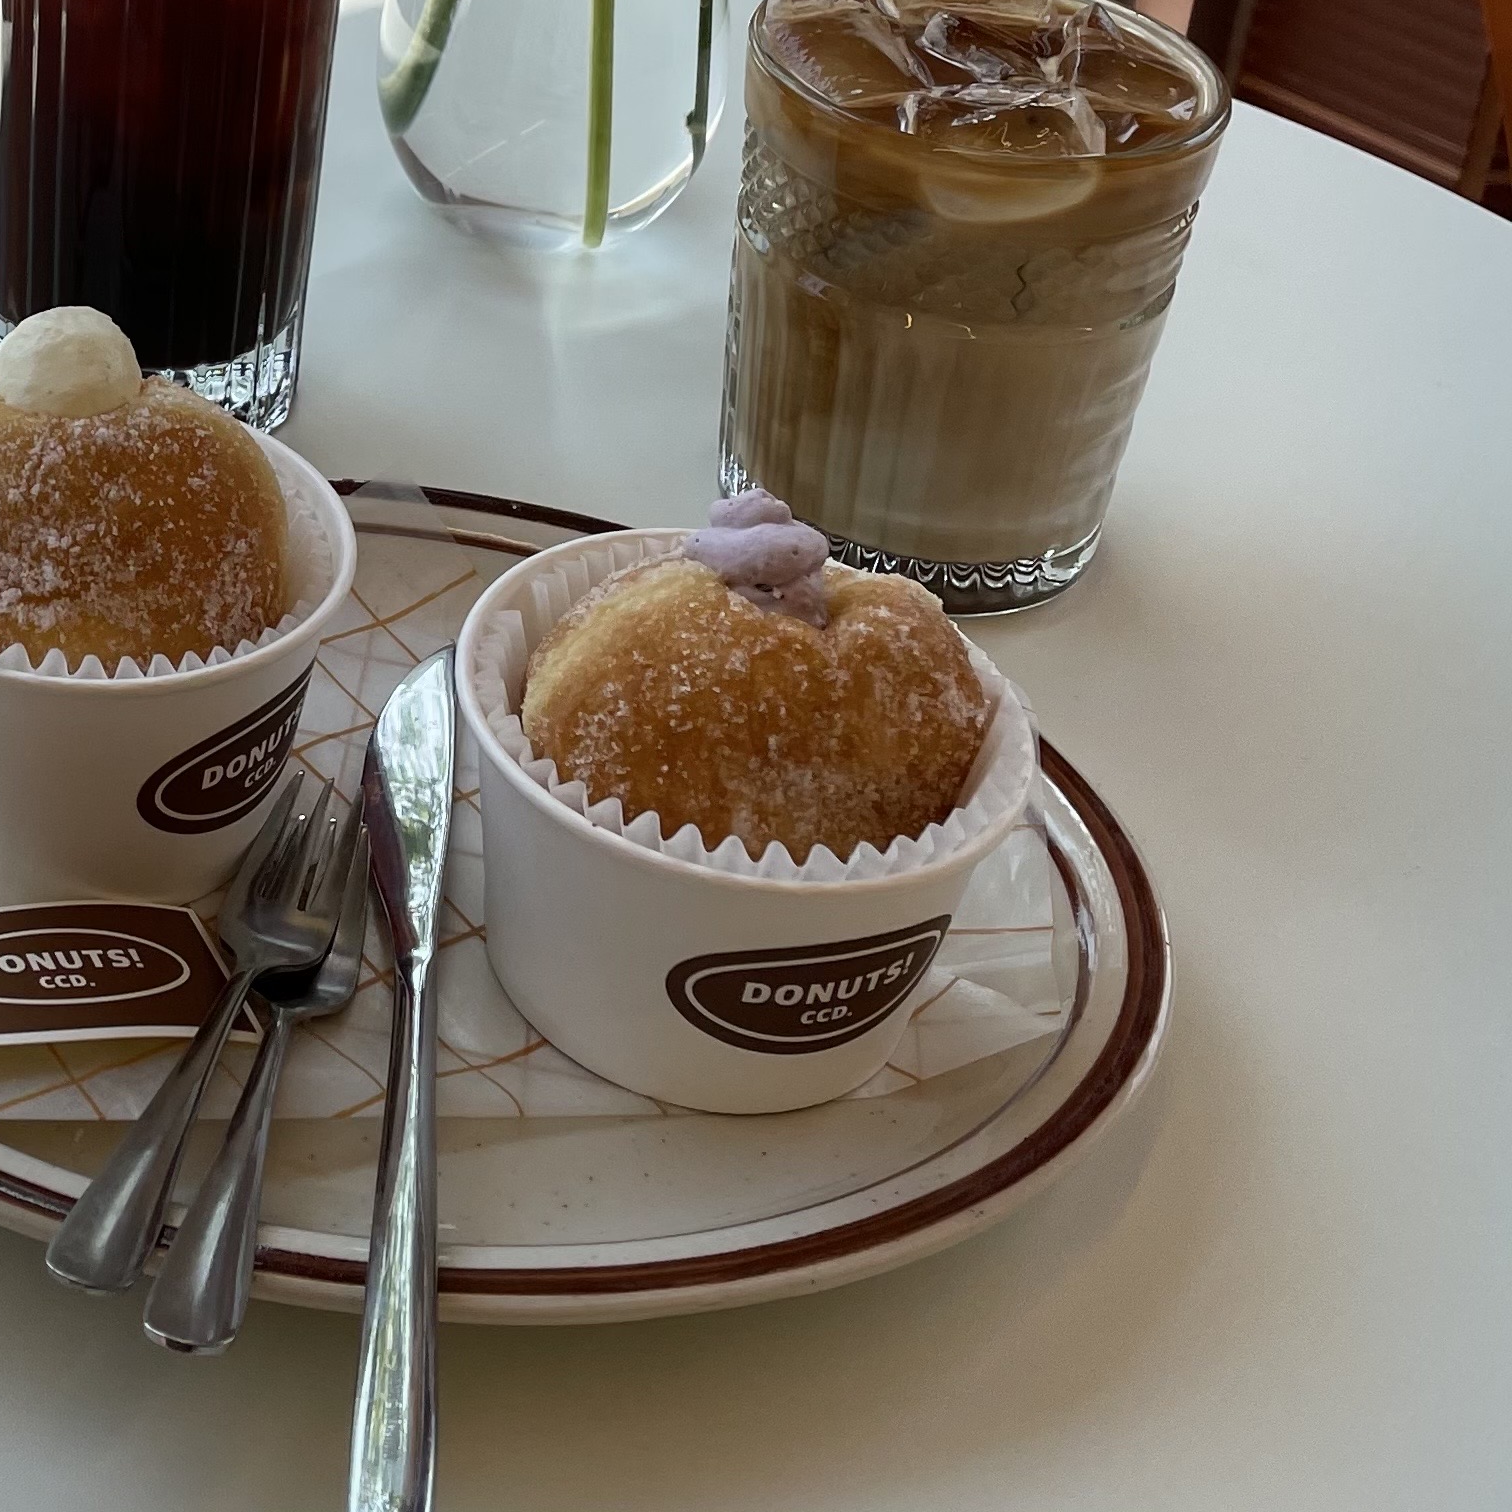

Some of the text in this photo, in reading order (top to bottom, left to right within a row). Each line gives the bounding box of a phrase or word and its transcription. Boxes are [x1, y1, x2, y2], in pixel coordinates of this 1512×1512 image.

[244, 756, 277, 788] CCD.
[38, 974, 96, 989] CCD.
[740, 951, 915, 1006] DONUTS!
[799, 1005, 853, 1025] CCD.
